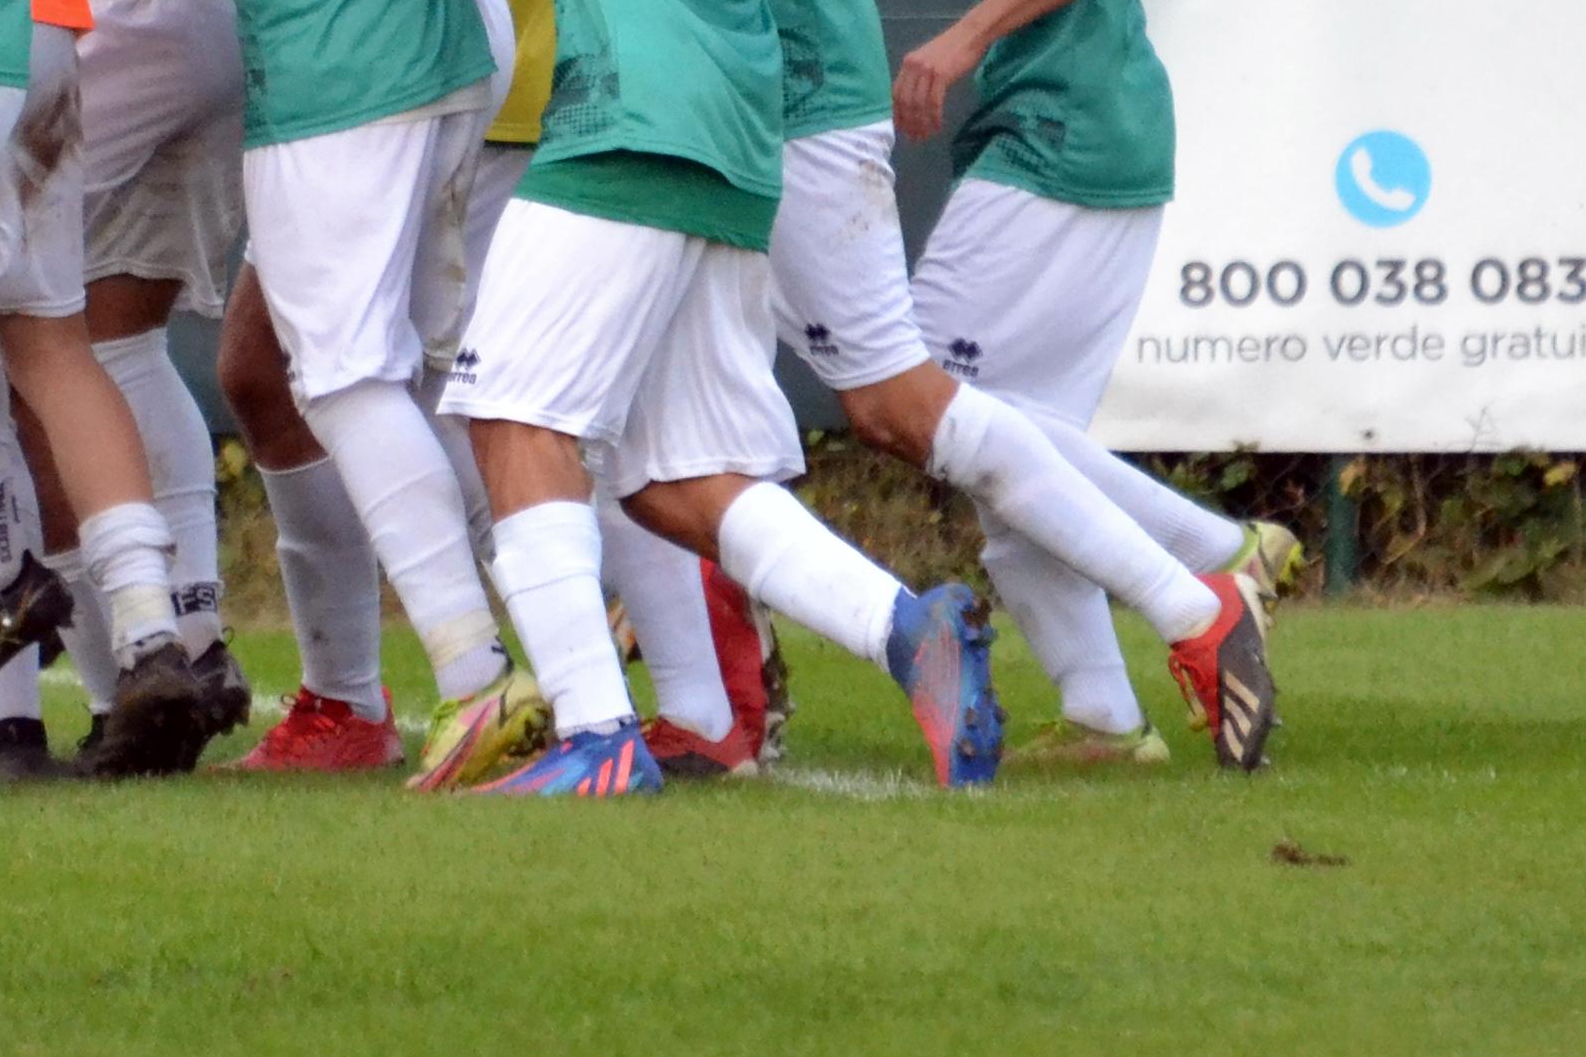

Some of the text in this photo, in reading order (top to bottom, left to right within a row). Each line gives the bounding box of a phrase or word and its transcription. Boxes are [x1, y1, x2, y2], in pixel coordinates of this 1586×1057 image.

[1179, 256, 1586, 308] 800 038 083
[1137, 332, 1308, 363] numero
[1323, 323, 1445, 362] verde
